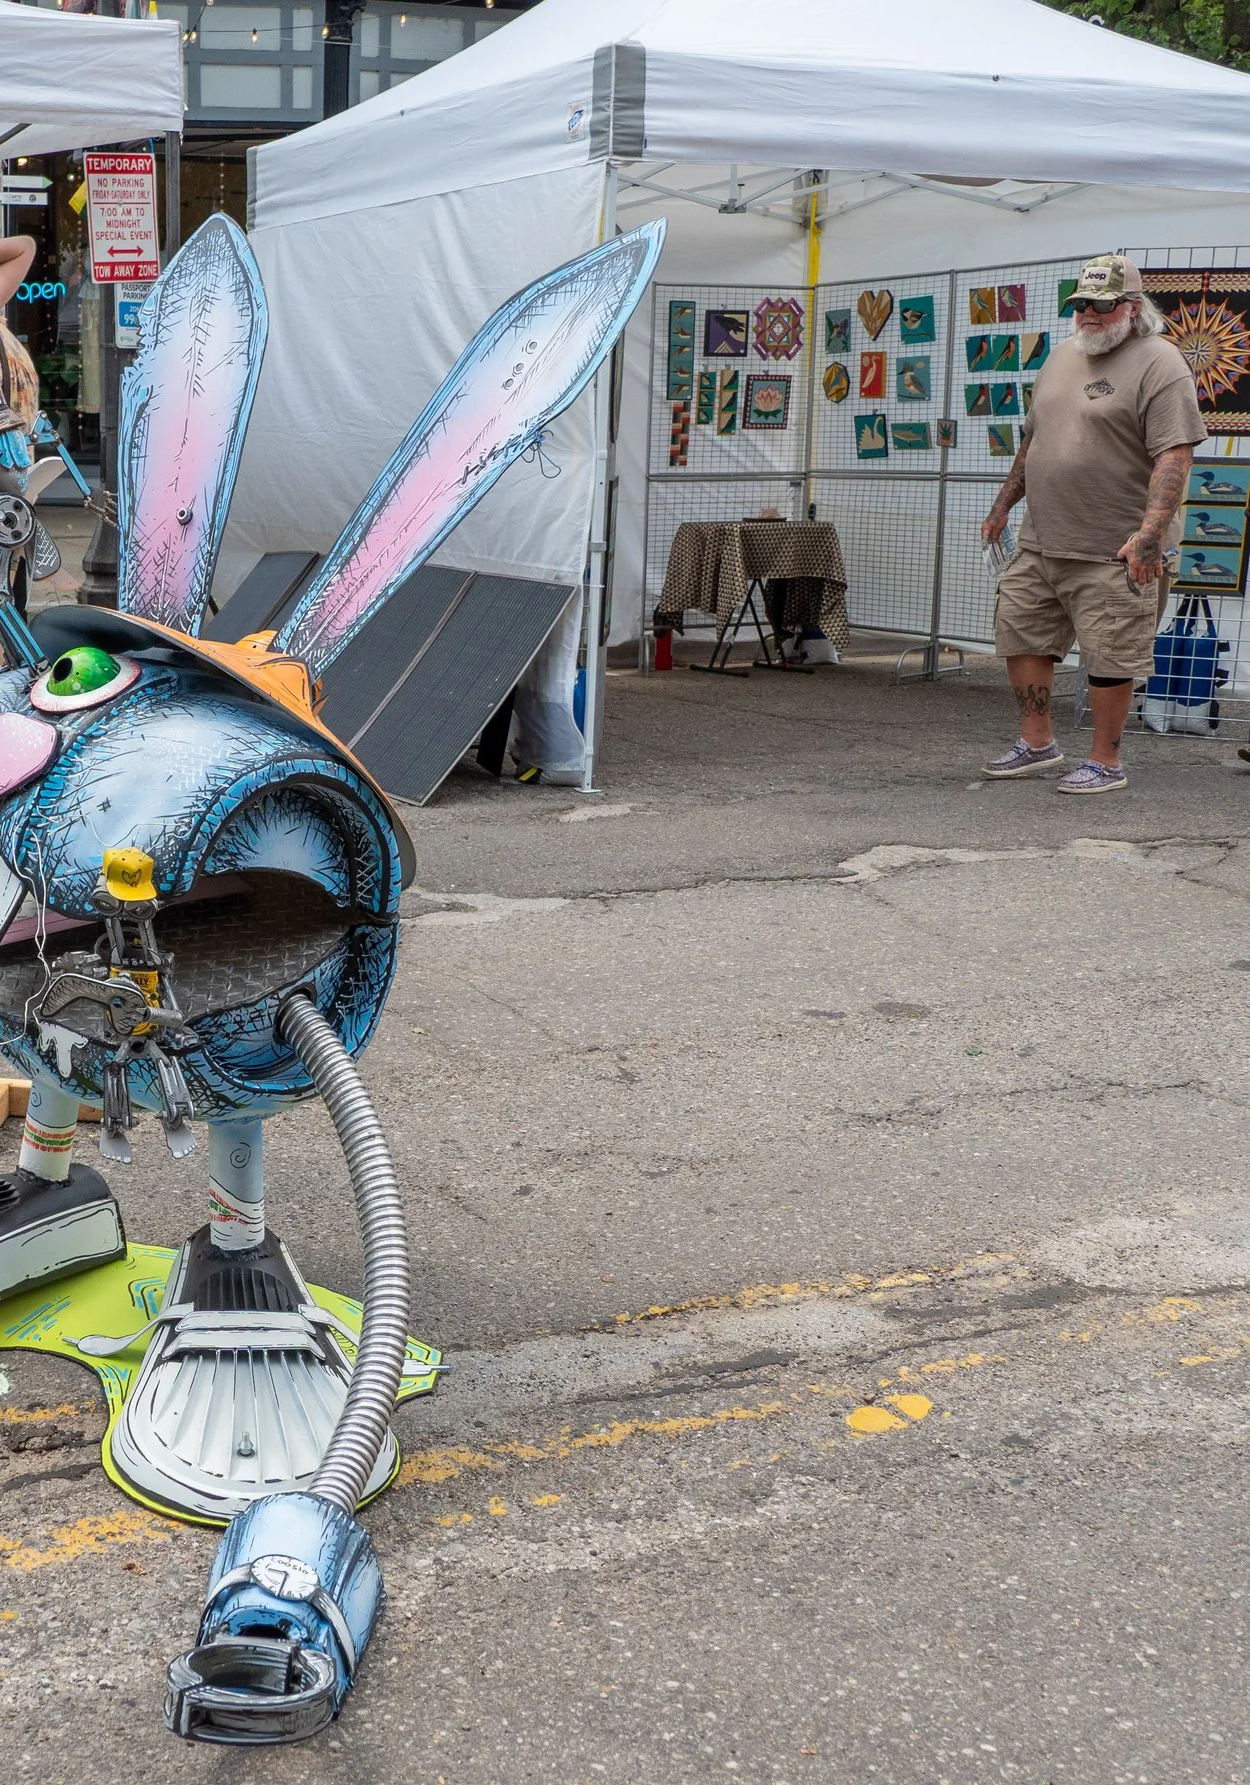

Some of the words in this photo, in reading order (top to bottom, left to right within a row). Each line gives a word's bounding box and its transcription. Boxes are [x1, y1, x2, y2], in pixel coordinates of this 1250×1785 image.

[86, 157, 152, 171] TEMPORARY
[97, 178, 108, 187] NO
[111, 178, 145, 188] PARKING
[138, 190, 150, 199] ONLY
[100, 207, 118, 217] 7:00
[121, 207, 132, 217] AM
[135, 207, 145, 217] TO
[105, 219, 141, 228] MIDNIGHT
[95, 231, 126, 241] SPECIAL
[130, 231, 152, 240] EVENT
[94, 265, 111, 278] TOW
[114, 265, 135, 278] AWAY
[138, 264, 158, 276] ZONE
[1085, 271, 1107, 281] Jeep
[121, 283, 150, 292] PASSPORT
[16, 282, 67, 304] open
